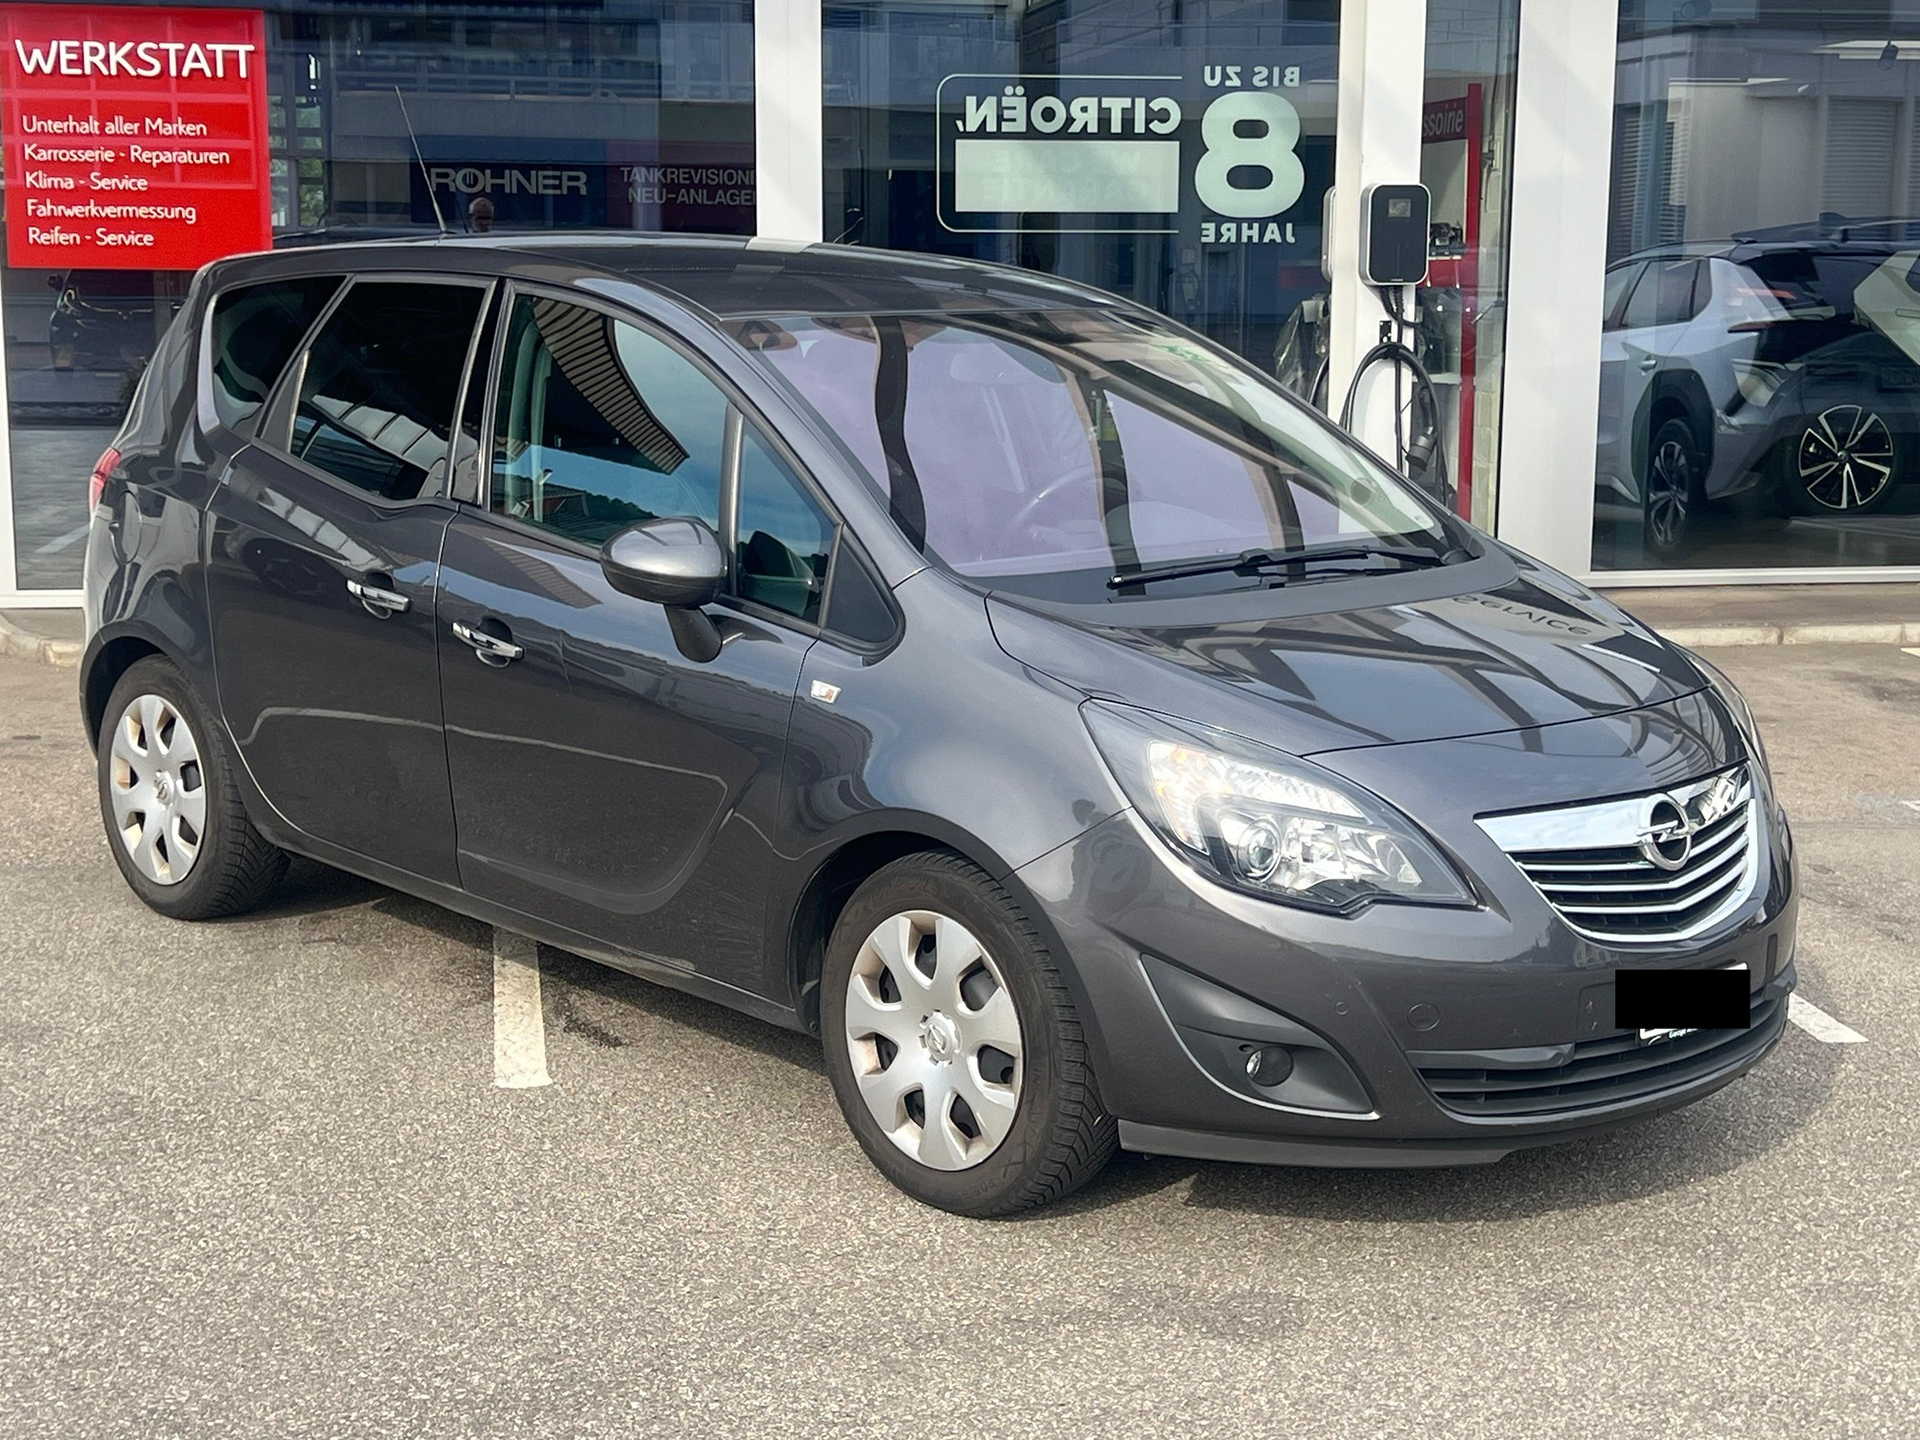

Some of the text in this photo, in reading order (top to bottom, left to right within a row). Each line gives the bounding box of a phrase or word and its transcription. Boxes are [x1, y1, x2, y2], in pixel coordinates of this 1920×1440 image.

[14, 38, 256, 79] WERKSTATT
[22, 115, 208, 137] Unterhalt aller Marken
[24, 143, 115, 164] Karrosserie
[130, 144, 230, 168] Reparaturen
[25, 171, 75, 191] Klima
[89, 171, 149, 192] Service
[628, 187, 755, 206] NEU-ANLAGE
[26, 198, 197, 224] Fahrwerkvermessung
[28, 226, 80, 246] Reifen
[95, 227, 155, 247] Service
